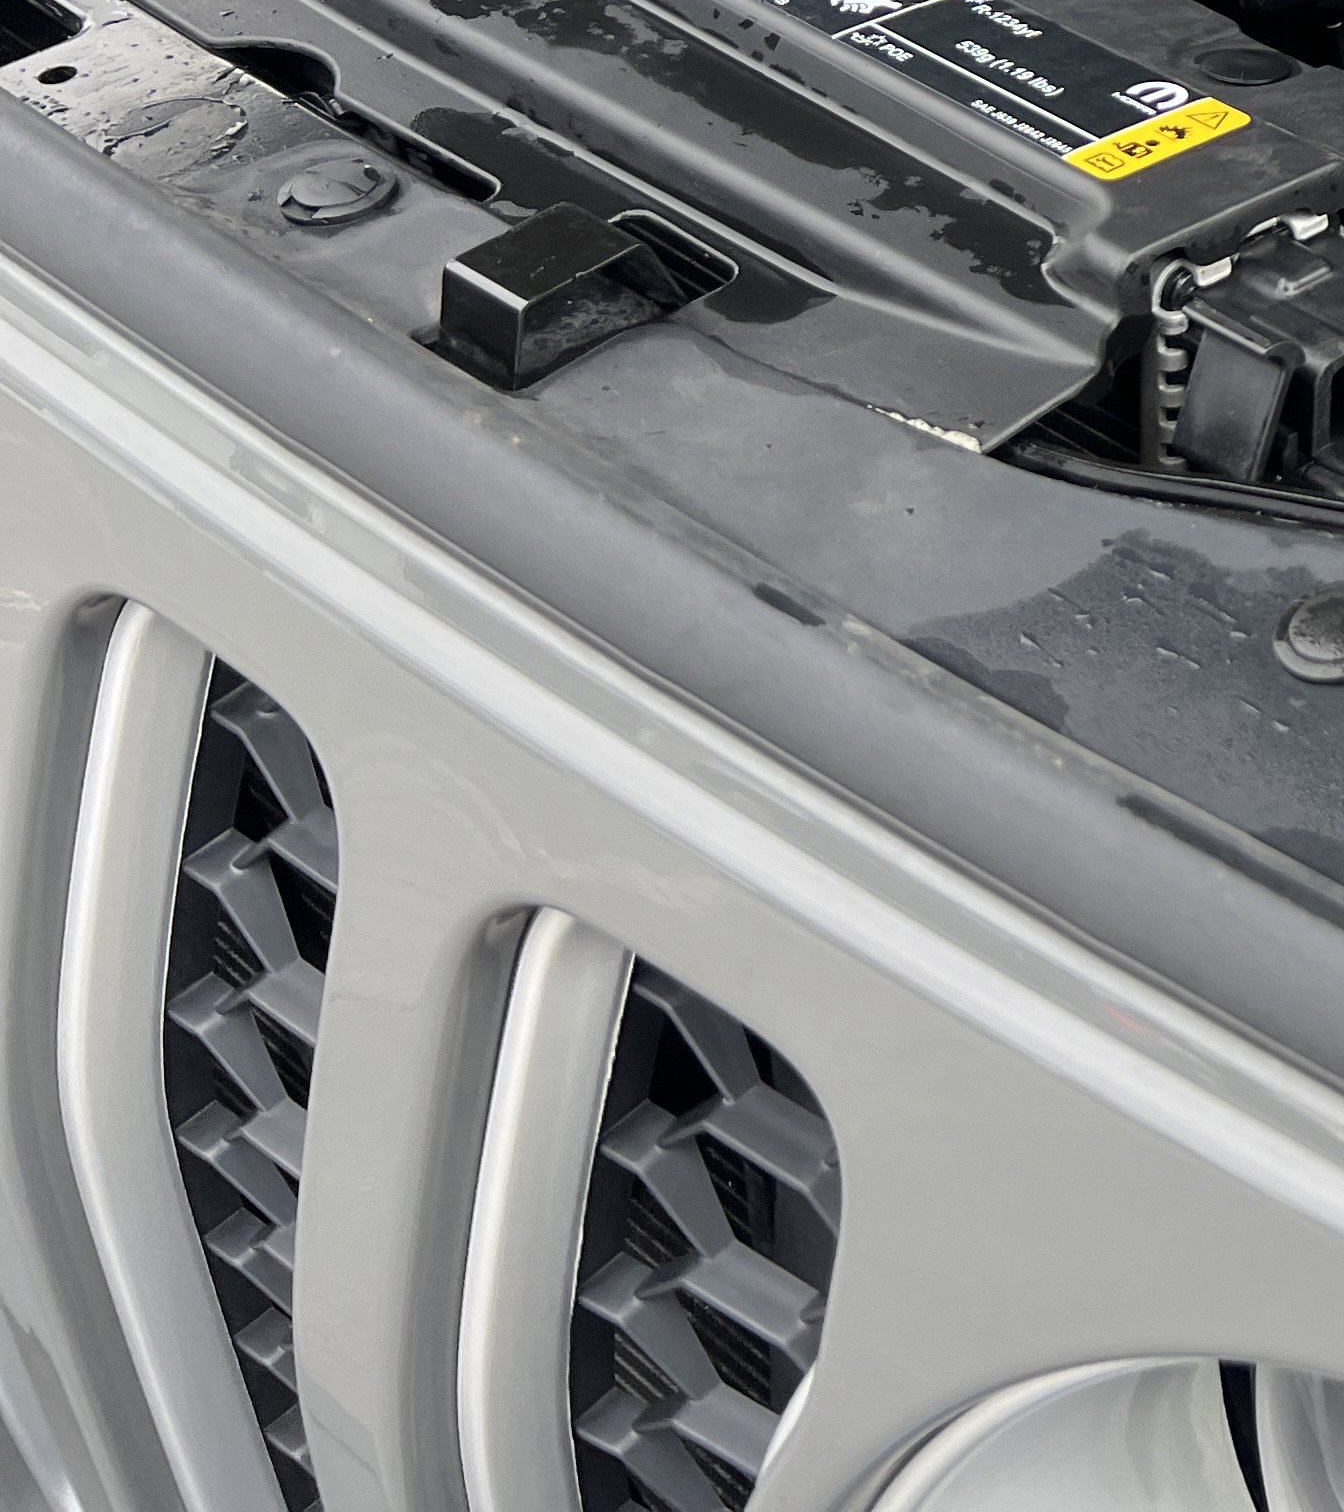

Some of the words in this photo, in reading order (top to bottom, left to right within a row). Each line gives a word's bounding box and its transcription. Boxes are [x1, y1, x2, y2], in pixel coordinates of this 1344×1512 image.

[970, 4, 1043, 38] R-1234yf
[880, 44, 914, 63] POE
[955, 40, 996, 64] 539g
[1027, 76, 1065, 98] lbs)
[970, 99, 993, 114] SAE
